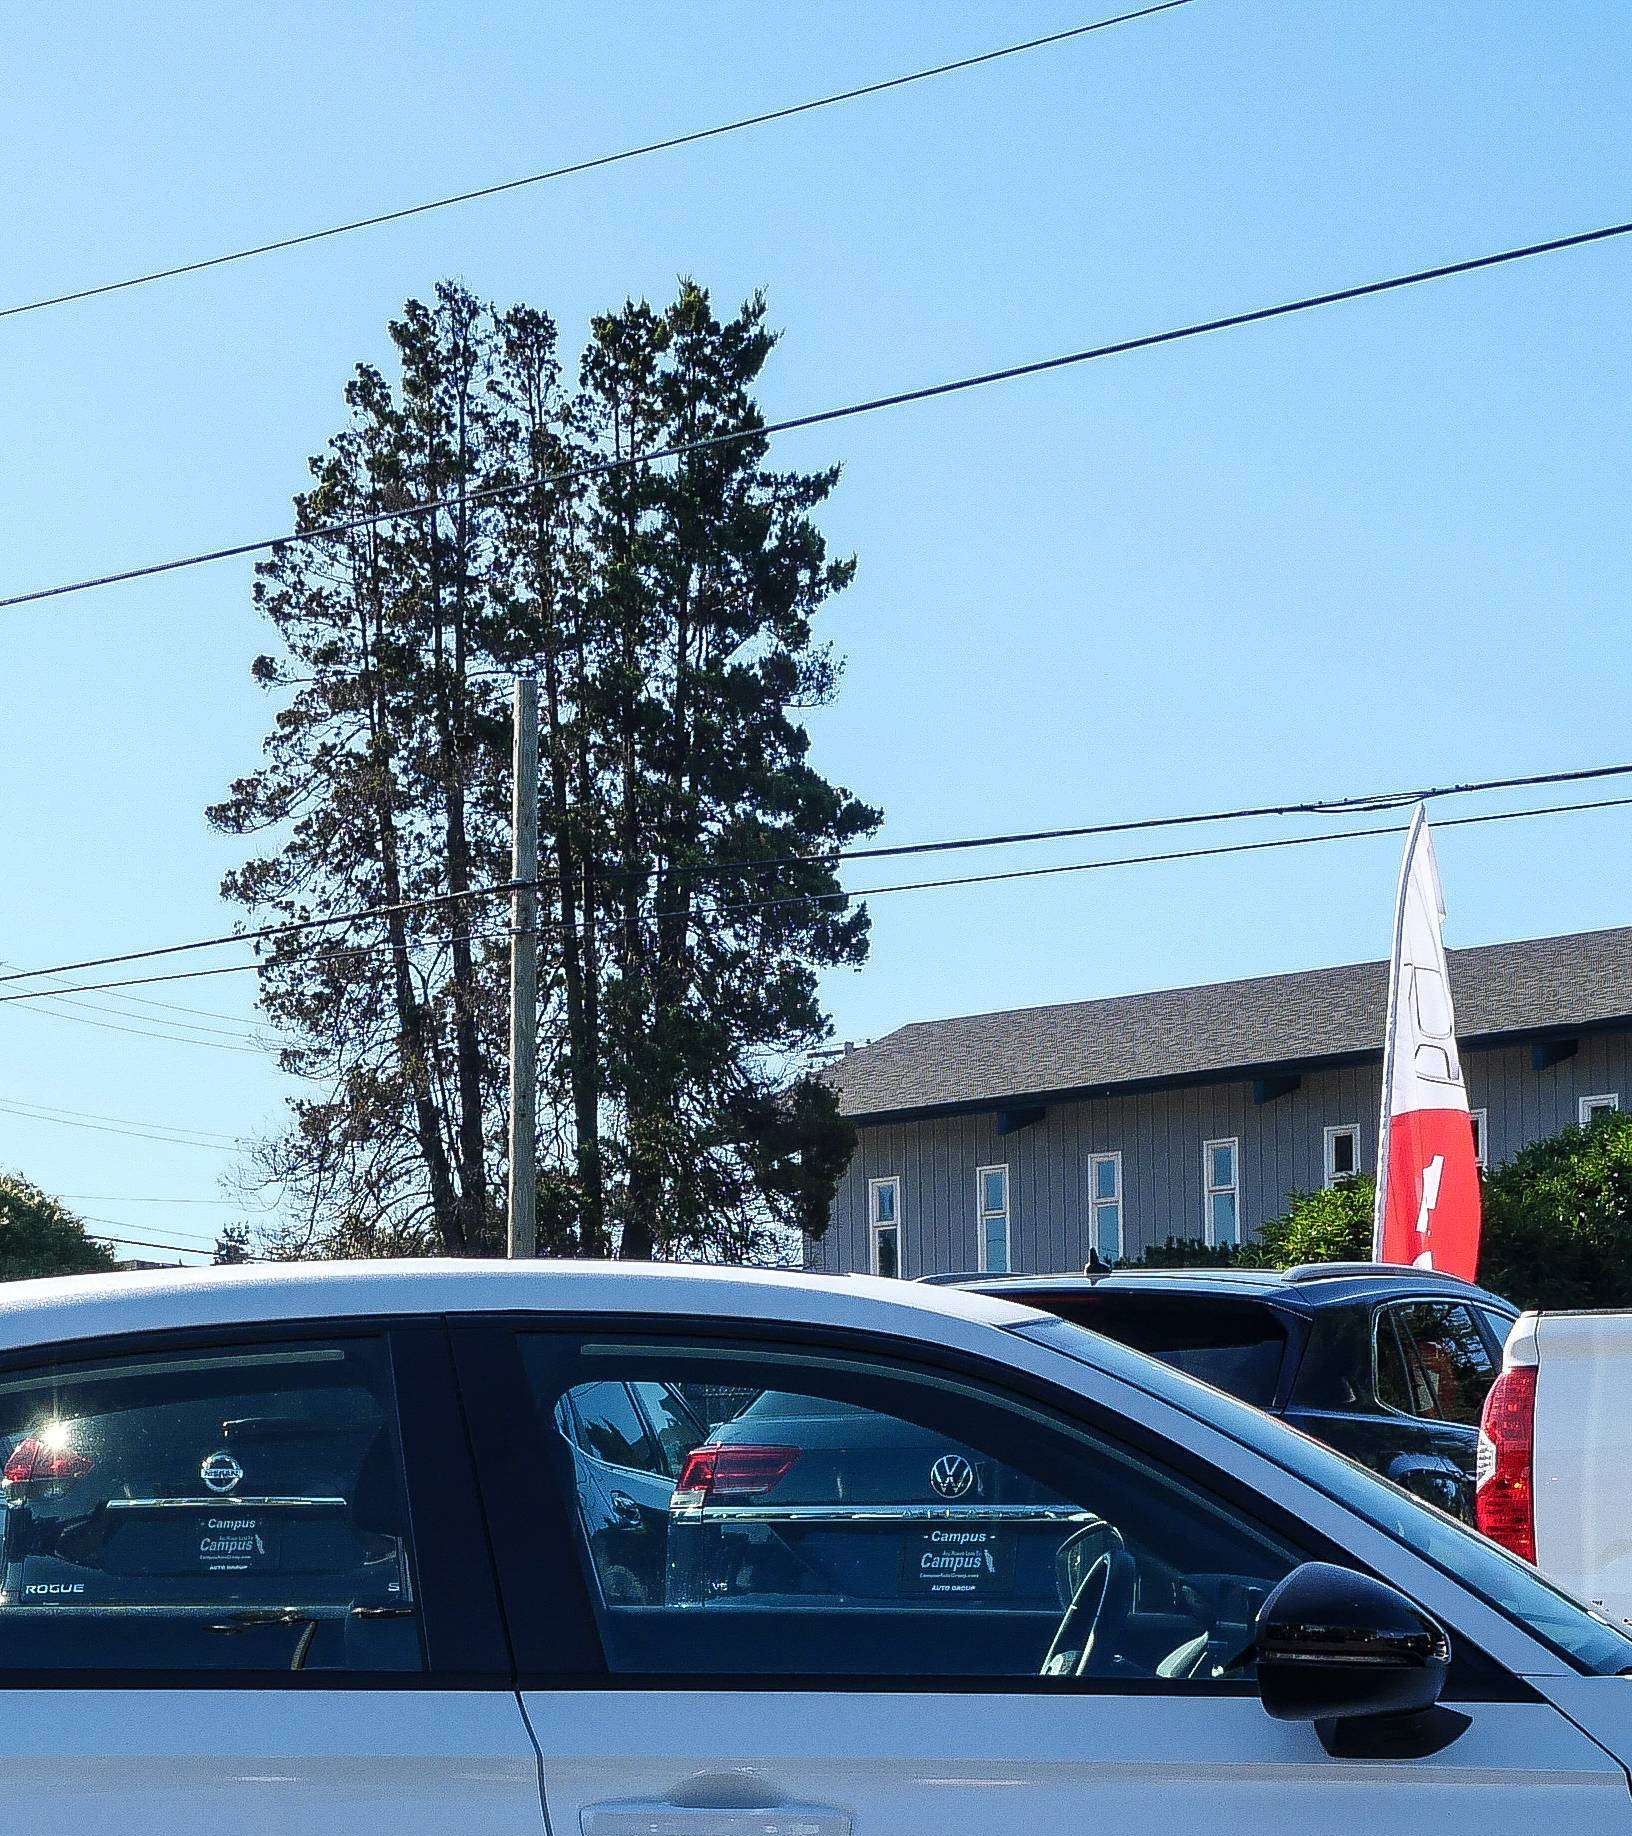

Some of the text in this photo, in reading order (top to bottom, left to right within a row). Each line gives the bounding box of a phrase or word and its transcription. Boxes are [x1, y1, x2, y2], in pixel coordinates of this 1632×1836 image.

[207, 1518, 256, 1531] Campus
[931, 1530, 987, 1545] Campus
[199, 1538, 254, 1554] Campus
[920, 1552, 982, 1572] Campus
[25, 1583, 85, 1595] ROGUE
